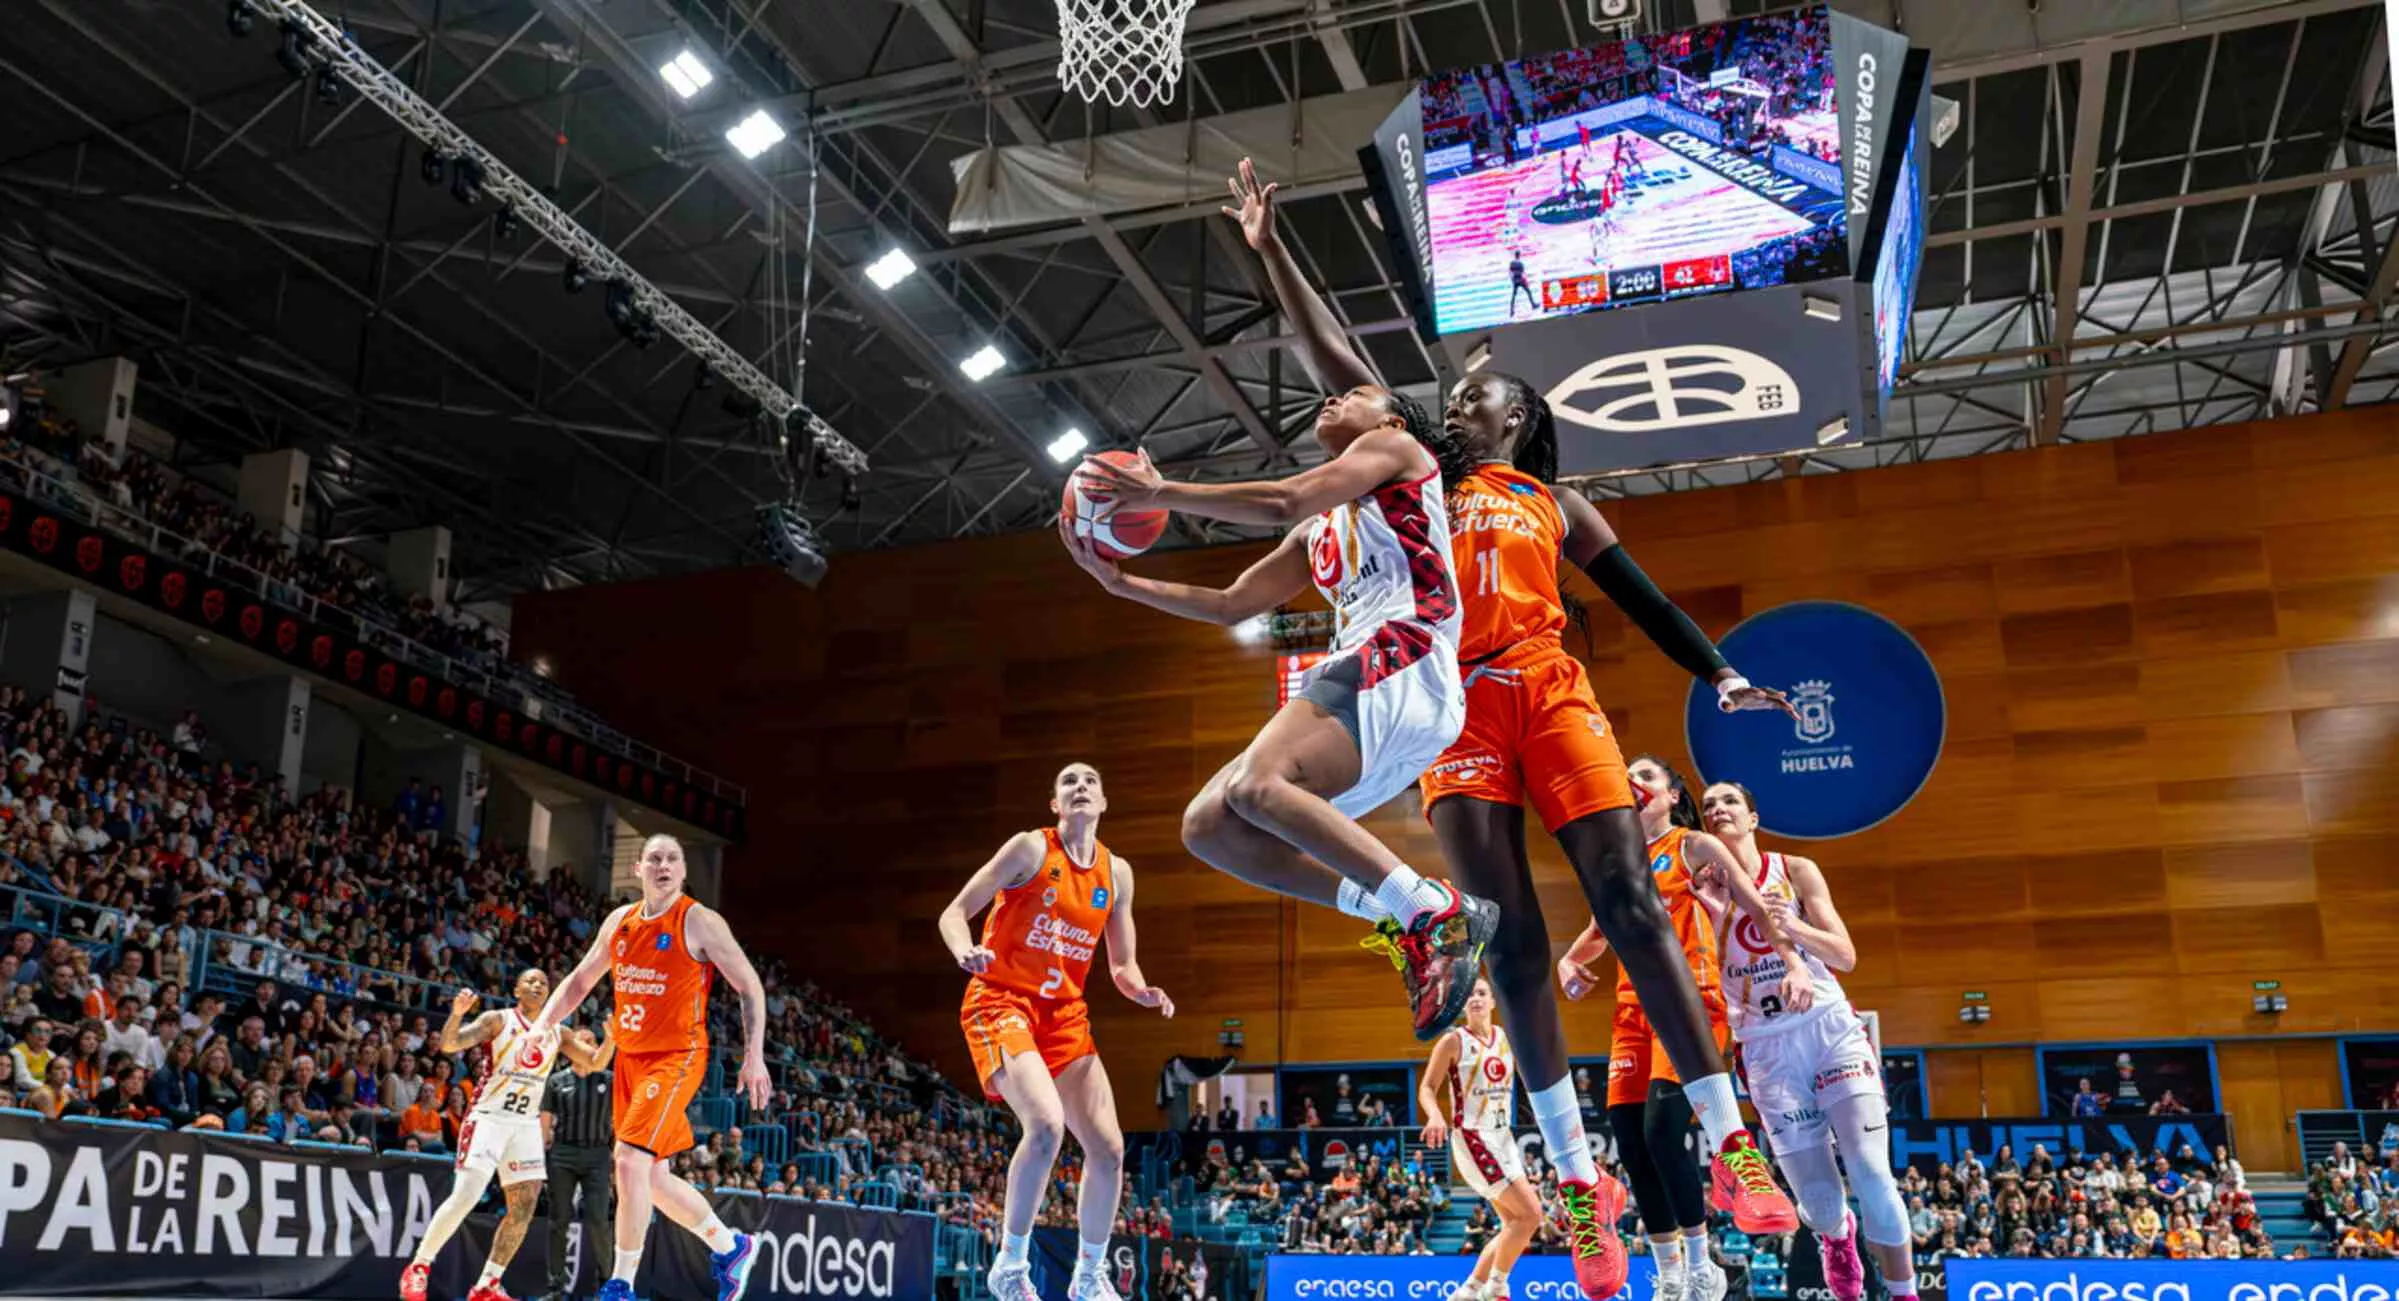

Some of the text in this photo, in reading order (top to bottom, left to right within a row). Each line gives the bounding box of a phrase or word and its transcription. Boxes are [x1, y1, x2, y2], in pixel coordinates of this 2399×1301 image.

[1856, 53, 1877, 122] COPA
[1396, 133, 1420, 199] COPA
[1850, 141, 1873, 215] REINA
[1616, 271, 1655, 295] 2:00
[1756, 384, 1783, 411] FEB
[1476, 547, 1499, 597] 11
[1782, 754, 1854, 774] HUELVA
[1025, 928, 1094, 962] Esfuerzo
[1034, 913, 1089, 943] Cultura
[1039, 966, 1064, 1000] 2
[620, 1004, 646, 1032] 22
[503, 1092, 530, 1115] 22
[1892, 1123, 2214, 1168] HUELVA
[0, 1139, 432, 1257] PA DE LA REINA
[759, 1213, 896, 1298] ndesa
